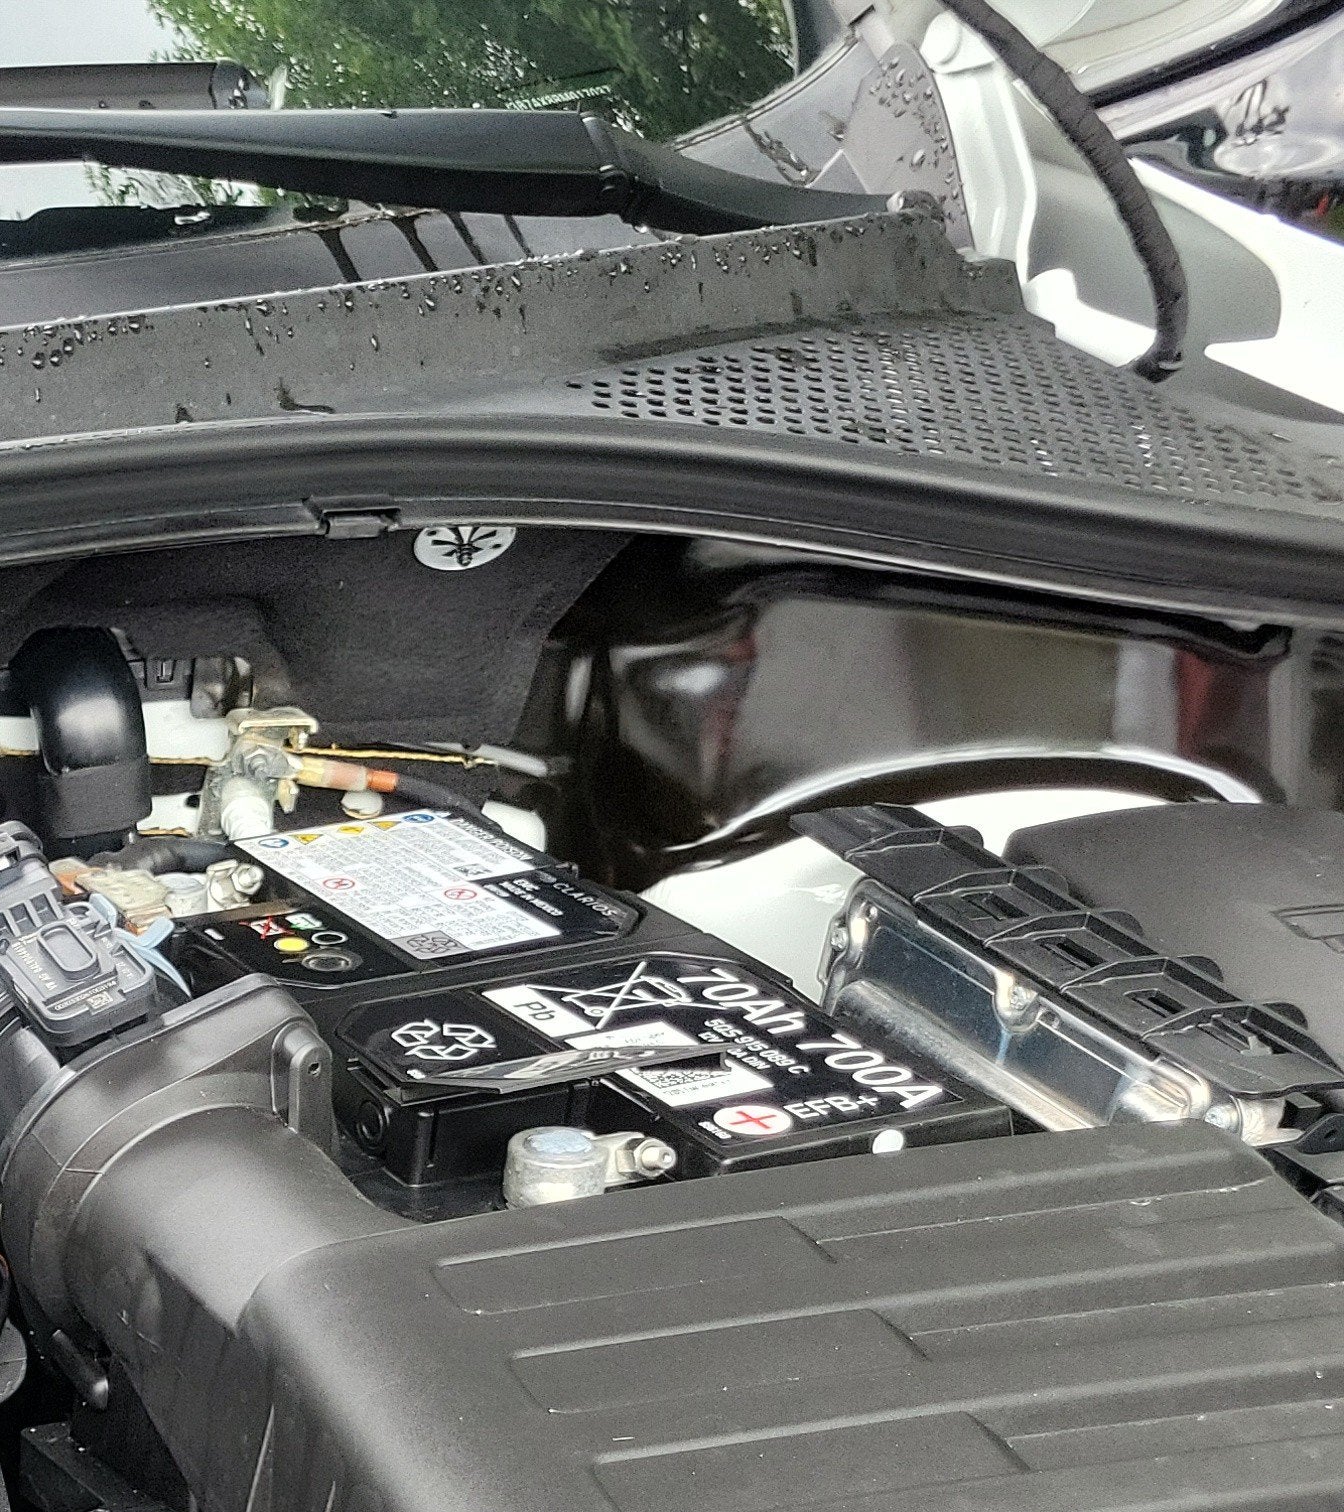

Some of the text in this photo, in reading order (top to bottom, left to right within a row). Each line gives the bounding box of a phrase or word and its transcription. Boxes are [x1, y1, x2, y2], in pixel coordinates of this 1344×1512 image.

[553, 881, 618, 917] CLARIOS
[512, 1001, 556, 1021] Pb
[676, 967, 943, 1110] 70Ah 700A
[733, 1031, 769, 1054] 915
[787, 1062, 811, 1076] C
[782, 1094, 880, 1120] EFB+
